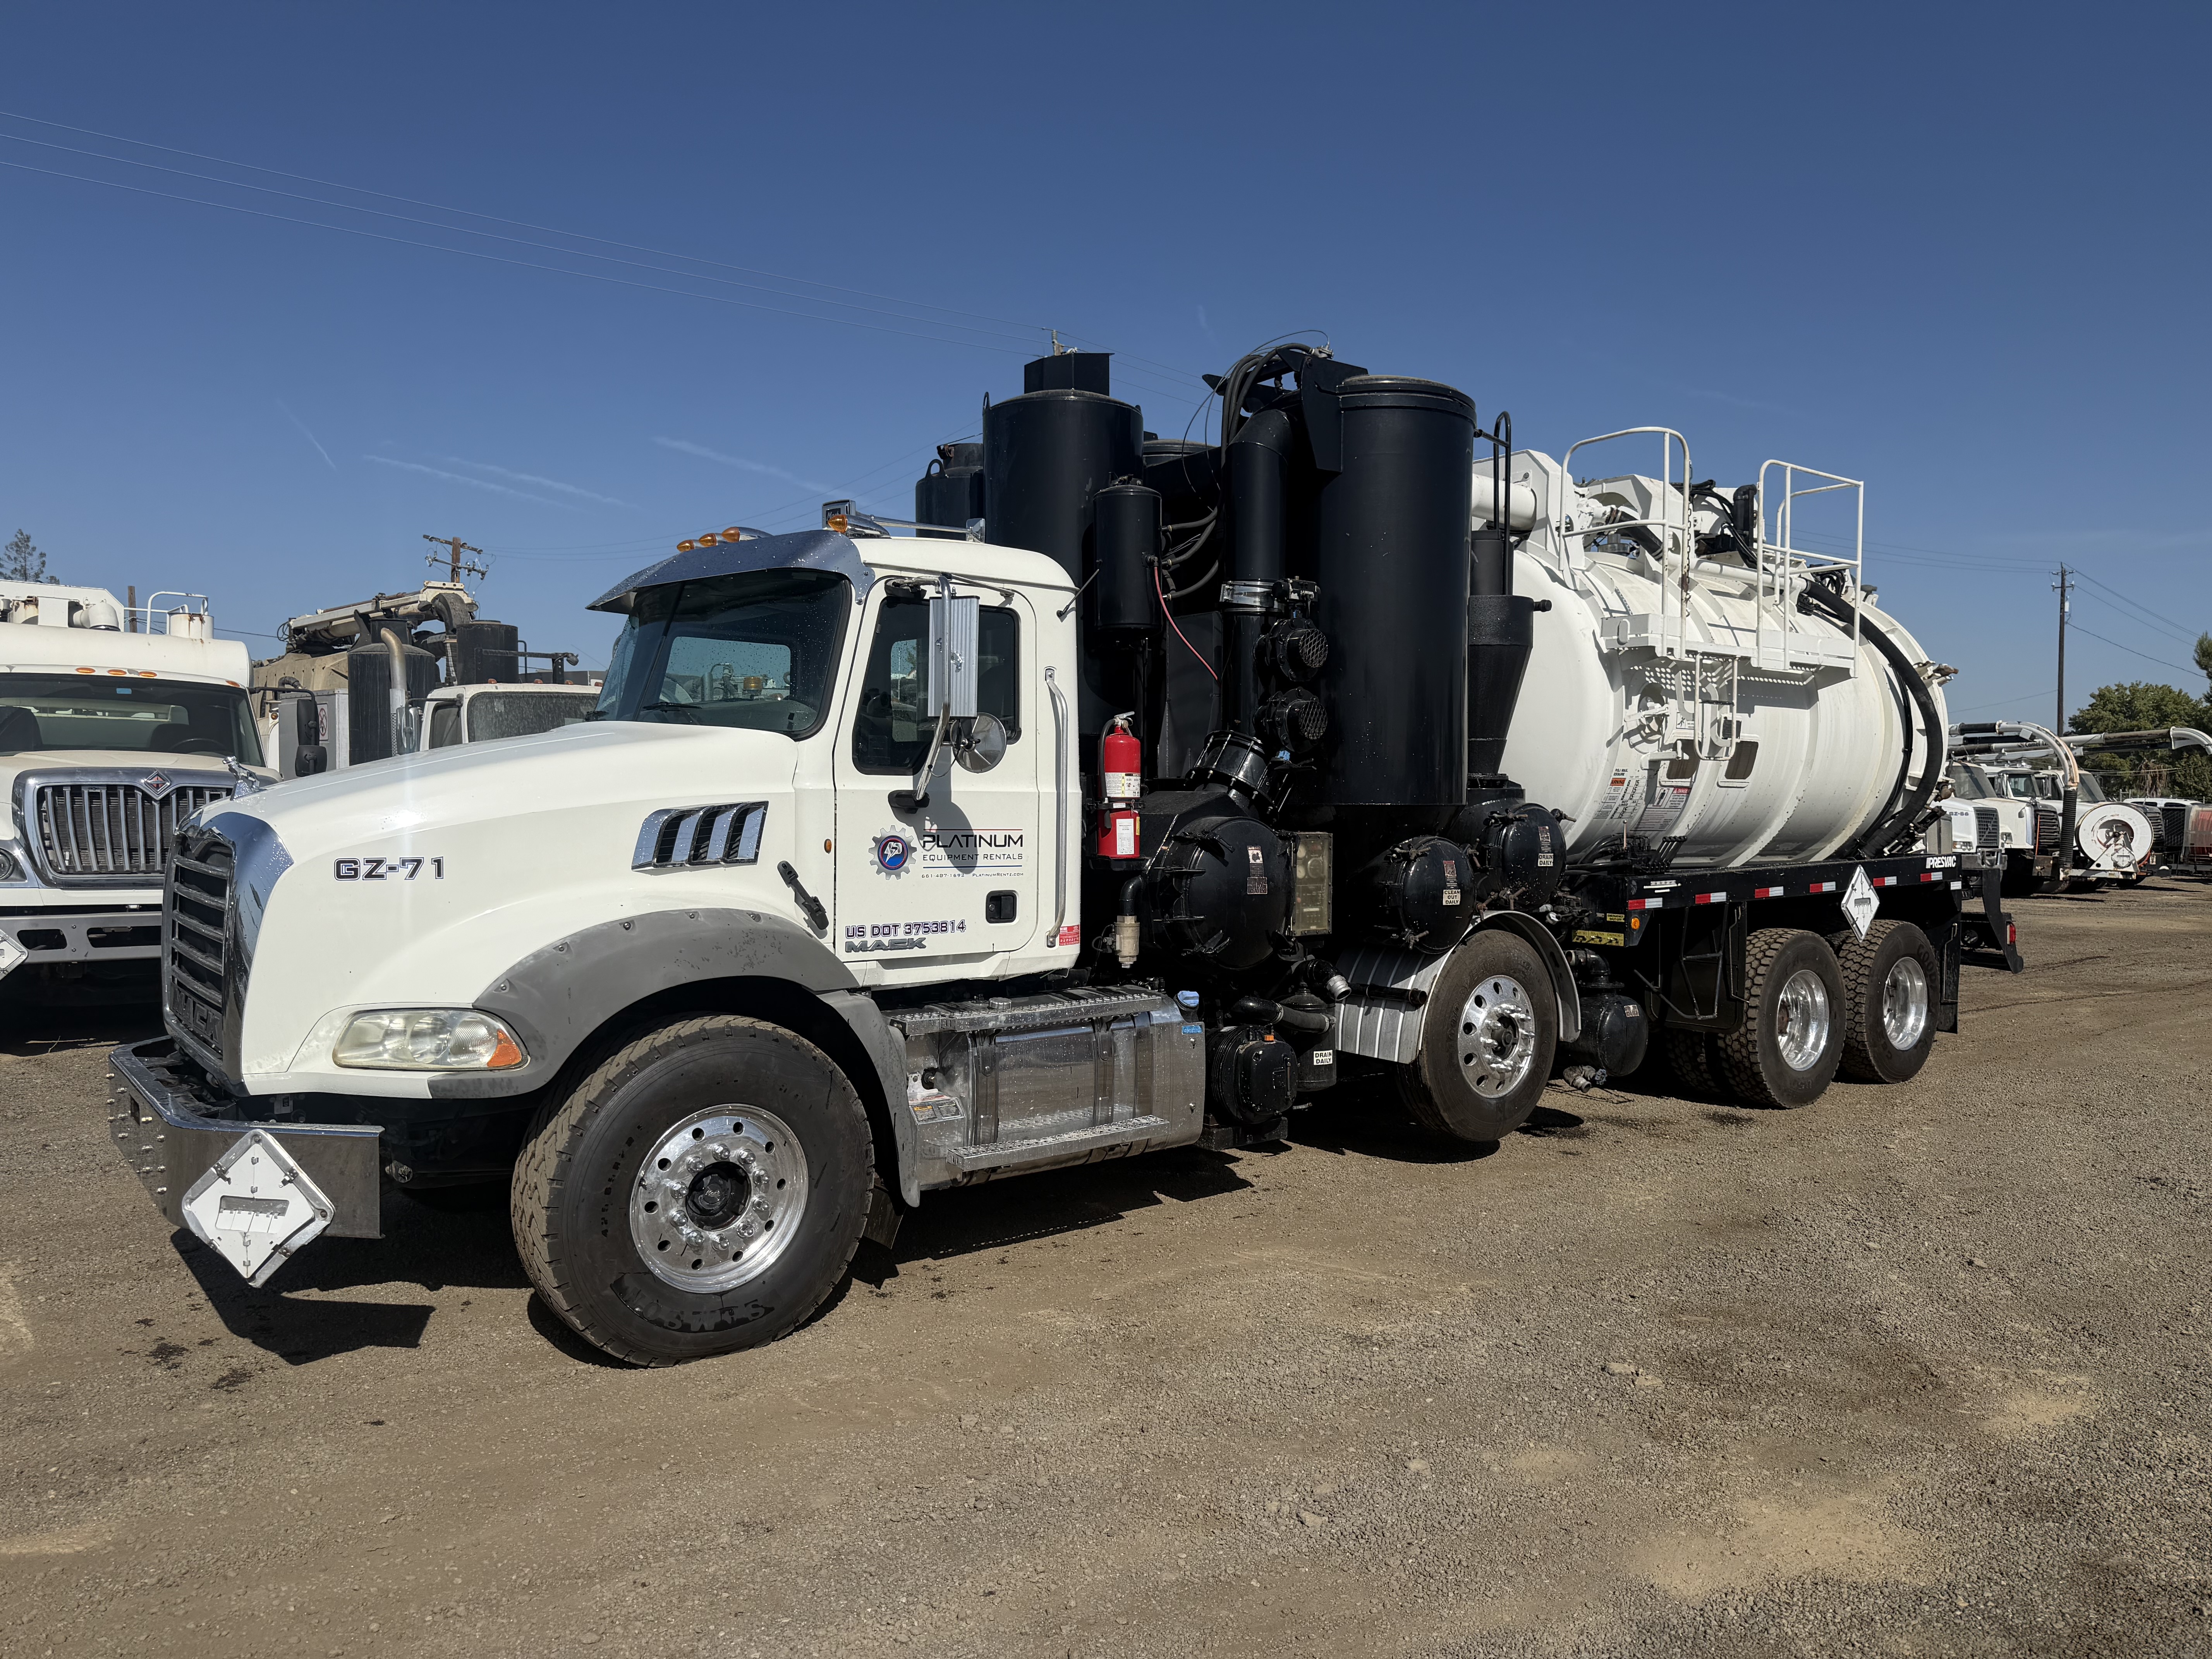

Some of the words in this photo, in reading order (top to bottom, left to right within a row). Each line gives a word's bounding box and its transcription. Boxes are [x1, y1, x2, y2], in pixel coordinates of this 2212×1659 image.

[922, 834, 1023, 848] PLATINUM
[922, 854, 980, 862] EQUIPMENT
[1930, 855, 1956, 869] PRESVAC
[334, 856, 444, 881] GZ-71
[845, 925, 866, 939] US
[871, 923, 901, 938] DOT
[903, 919, 966, 936] 3753814
[845, 937, 927, 953] MACK
[173, 988, 223, 1045] MACK
